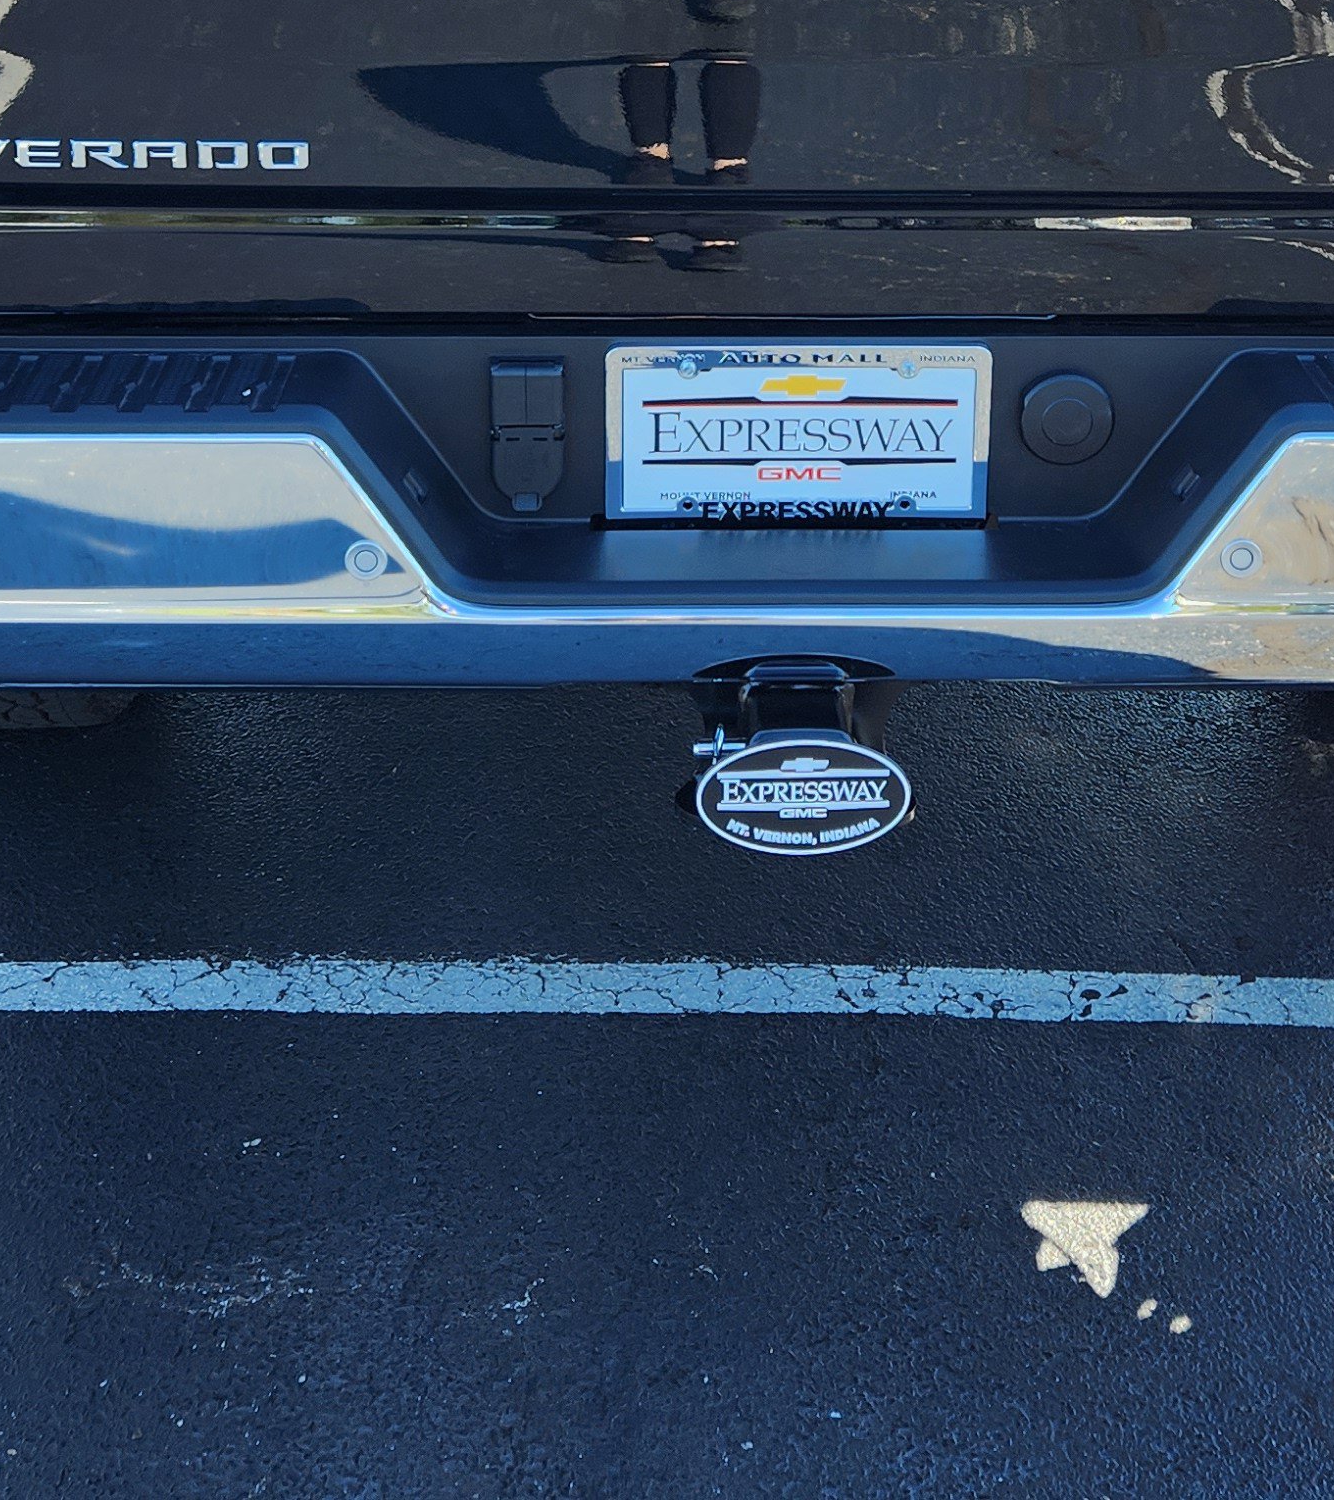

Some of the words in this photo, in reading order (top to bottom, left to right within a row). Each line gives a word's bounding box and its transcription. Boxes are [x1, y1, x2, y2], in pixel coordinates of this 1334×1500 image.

[718, 351, 801, 364] AUTO
[812, 353, 888, 364] MALL
[919, 354, 976, 363] INDIANA
[757, 466, 842, 481] GMC
[660, 491, 700, 500] MOT
[704, 491, 751, 500] VERNON
[890, 490, 937, 500] INANA
[701, 501, 891, 521] EXPRESSWAY
[779, 807, 828, 819] GMC
[726, 818, 750, 837] MT.
[752, 827, 818, 846] VERNON,
[819, 817, 881, 844] INDIANA
